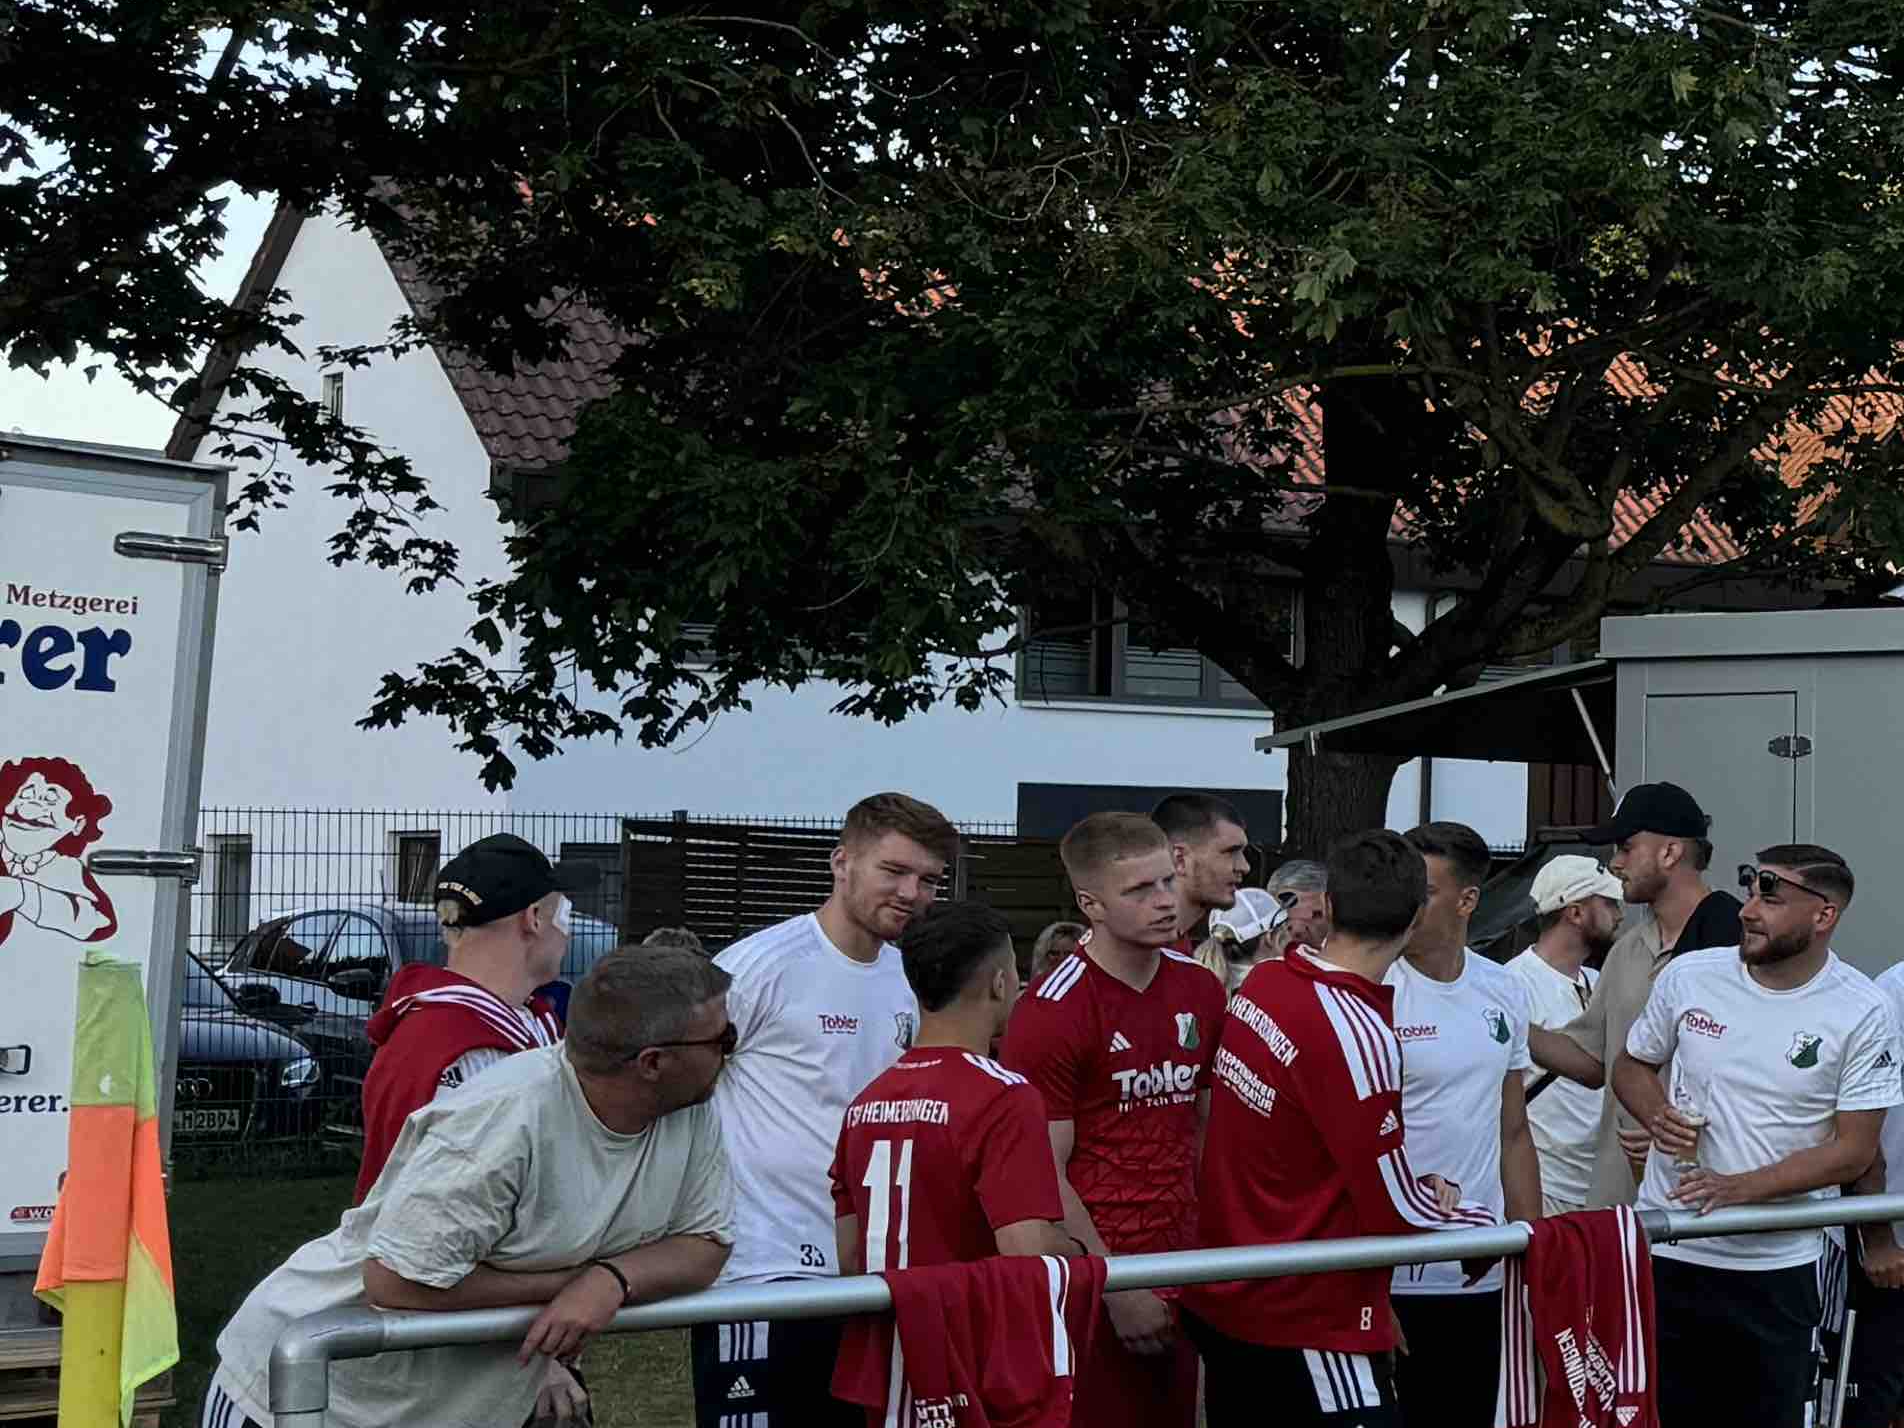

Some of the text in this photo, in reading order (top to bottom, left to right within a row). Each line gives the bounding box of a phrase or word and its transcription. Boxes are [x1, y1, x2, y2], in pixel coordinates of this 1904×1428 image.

[7, 583, 138, 615] Metzgerei
[862, 1139, 913, 1271] 11
[800, 1244, 826, 1267] 33
[1360, 1306, 1372, 1330] 8
